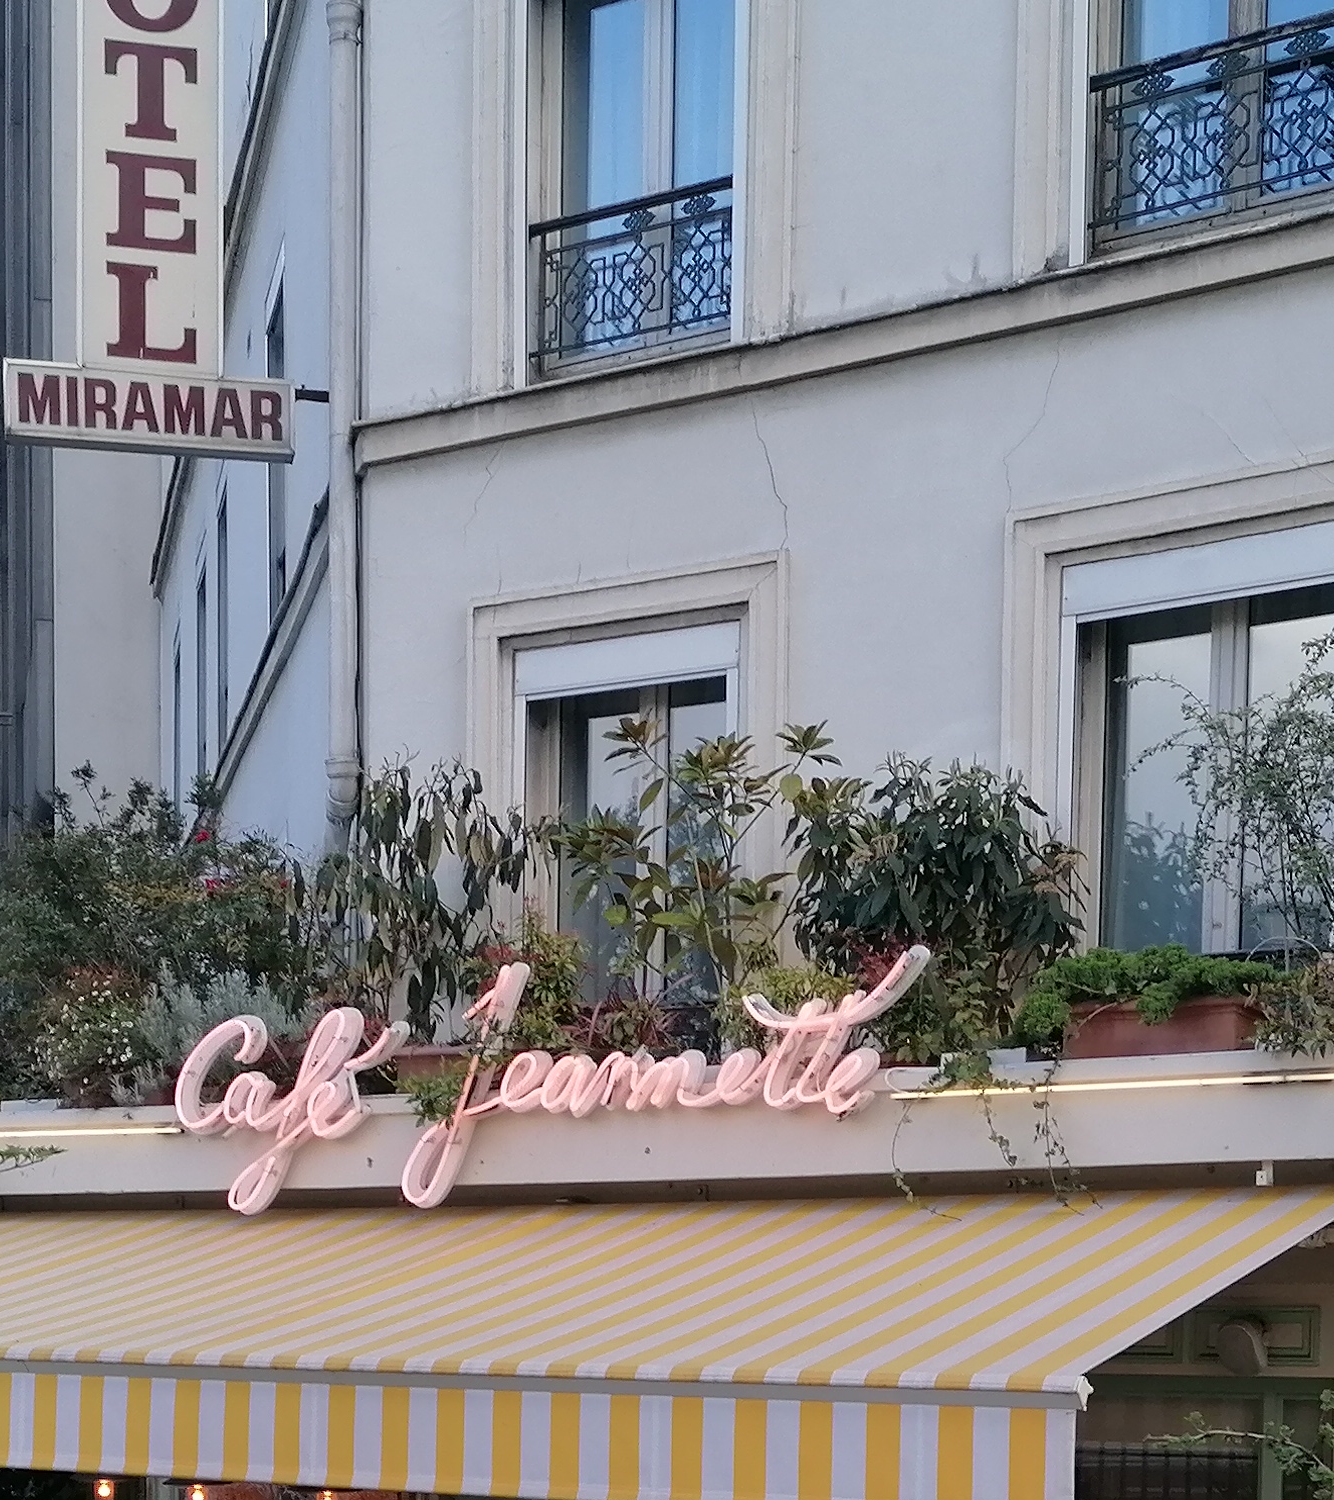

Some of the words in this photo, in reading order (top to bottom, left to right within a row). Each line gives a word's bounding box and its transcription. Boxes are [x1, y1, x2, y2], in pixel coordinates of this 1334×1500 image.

[17, 372, 284, 441] MIRAMAR
[176, 1006, 411, 1216] Café
[402, 945, 931, 1209] Jeannette
